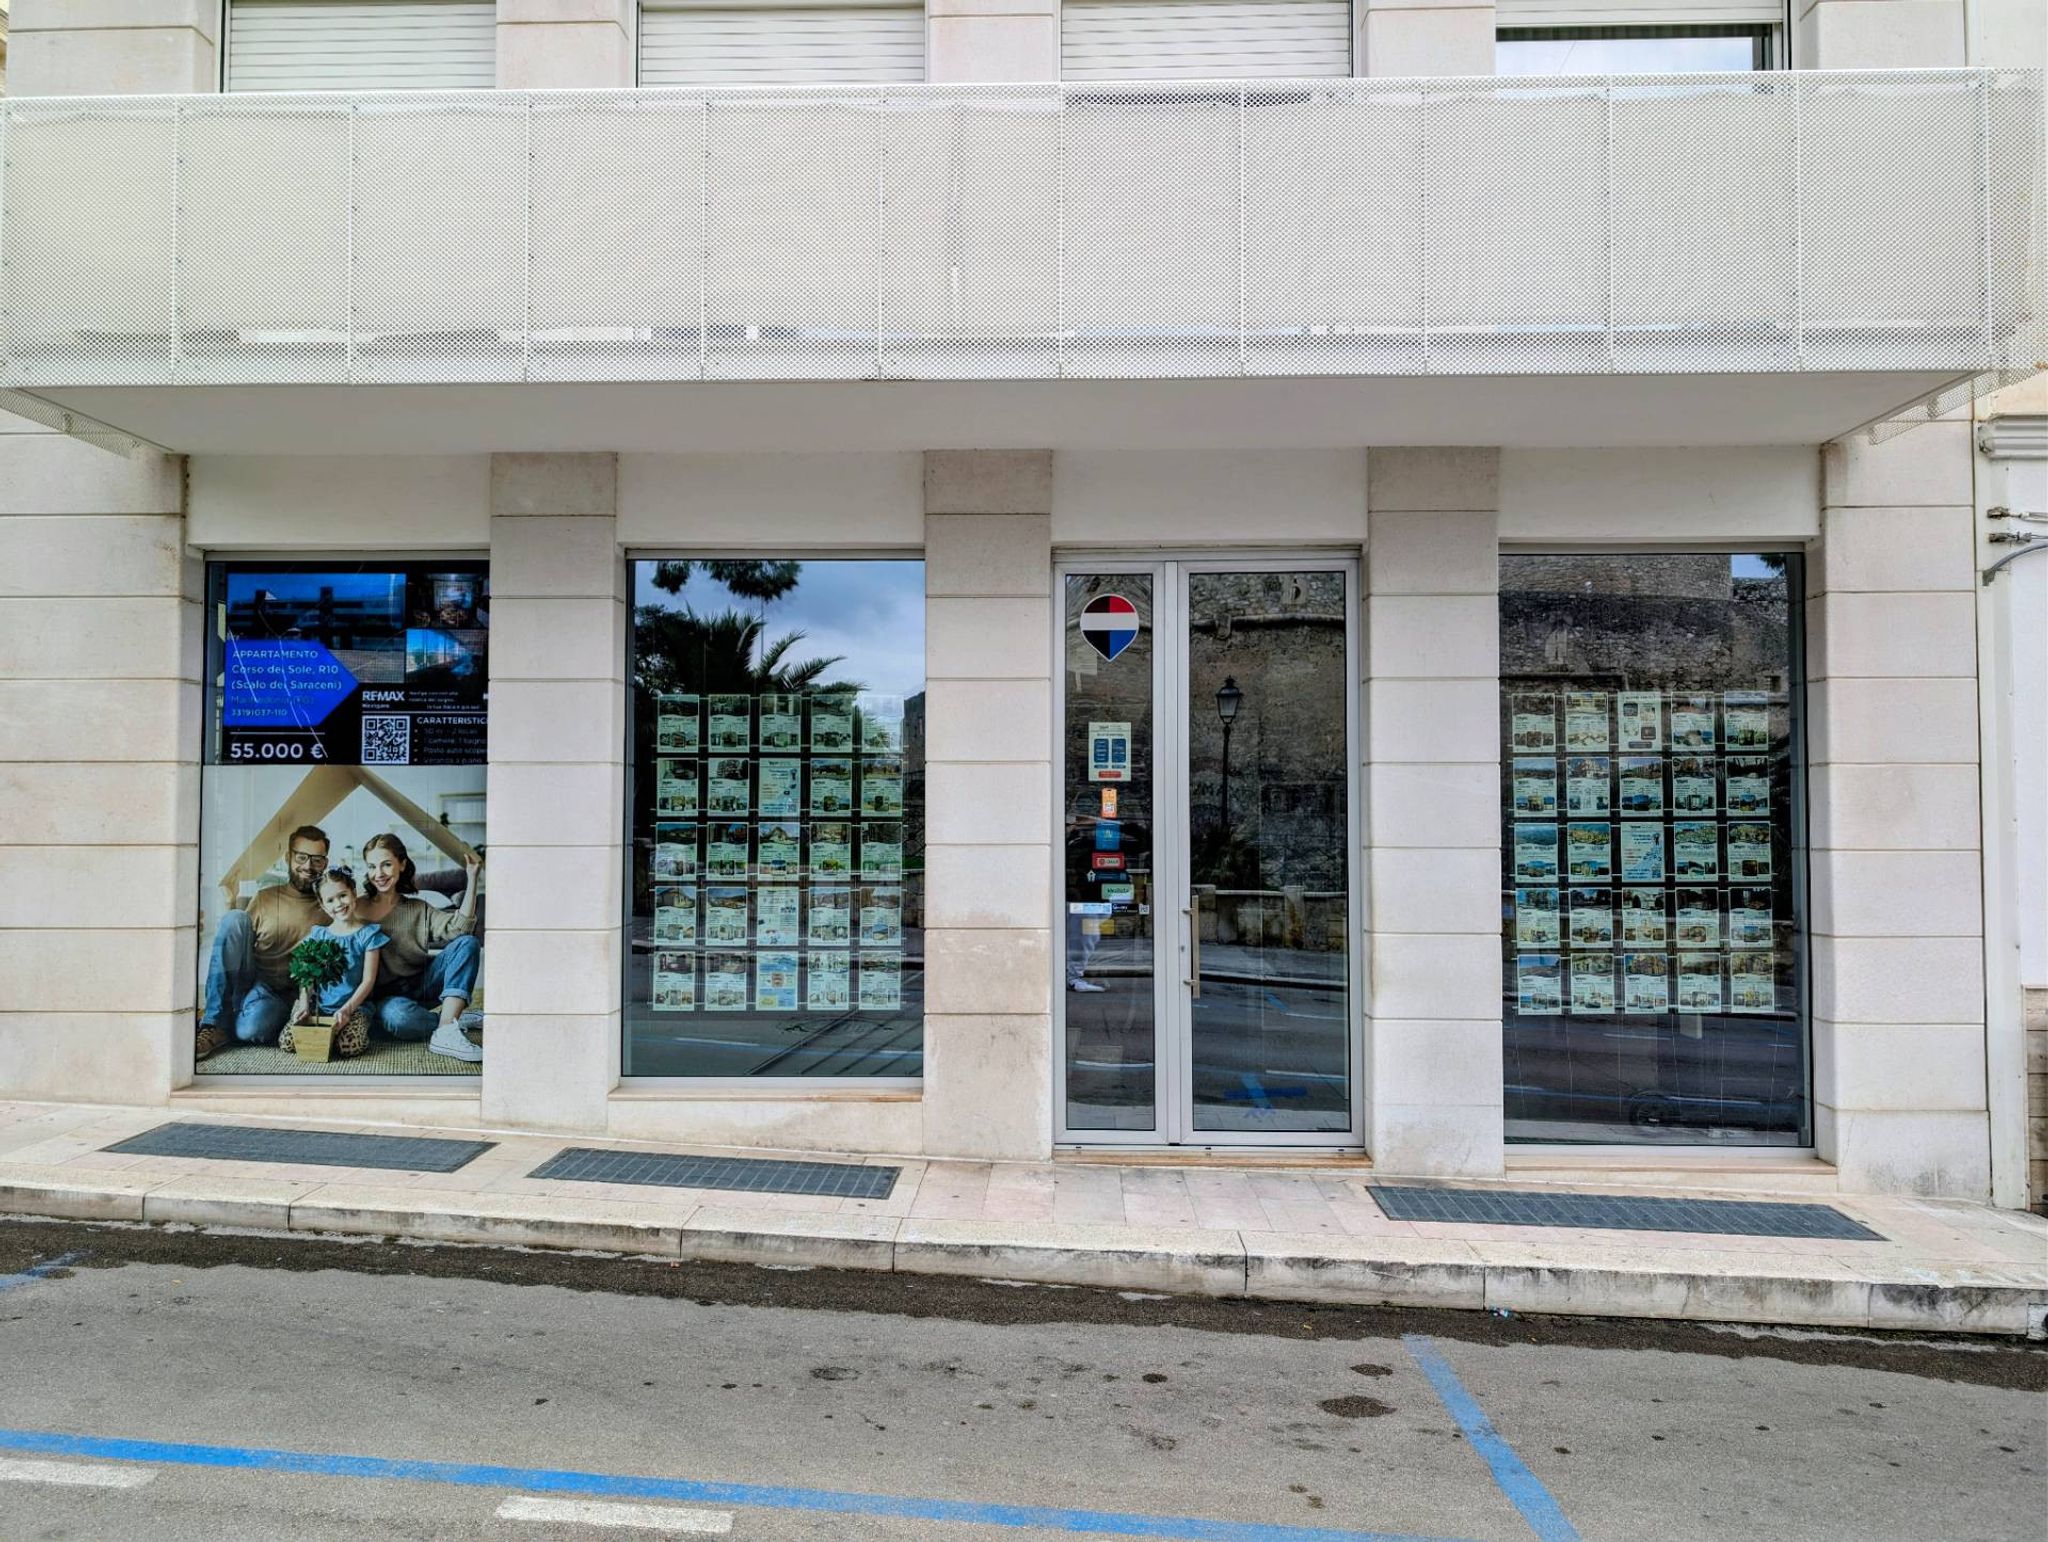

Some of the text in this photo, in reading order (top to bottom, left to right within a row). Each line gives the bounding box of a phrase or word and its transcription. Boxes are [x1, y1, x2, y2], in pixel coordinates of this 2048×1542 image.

[232, 650, 319, 659] APPARTAMENTO
[231, 664, 264, 674] Corso
[318, 664, 339, 674] R10
[231, 680, 266, 691] (Scalo
[290, 680, 342, 691] Saraceni)
[229, 742, 324, 759] 55.000 €
